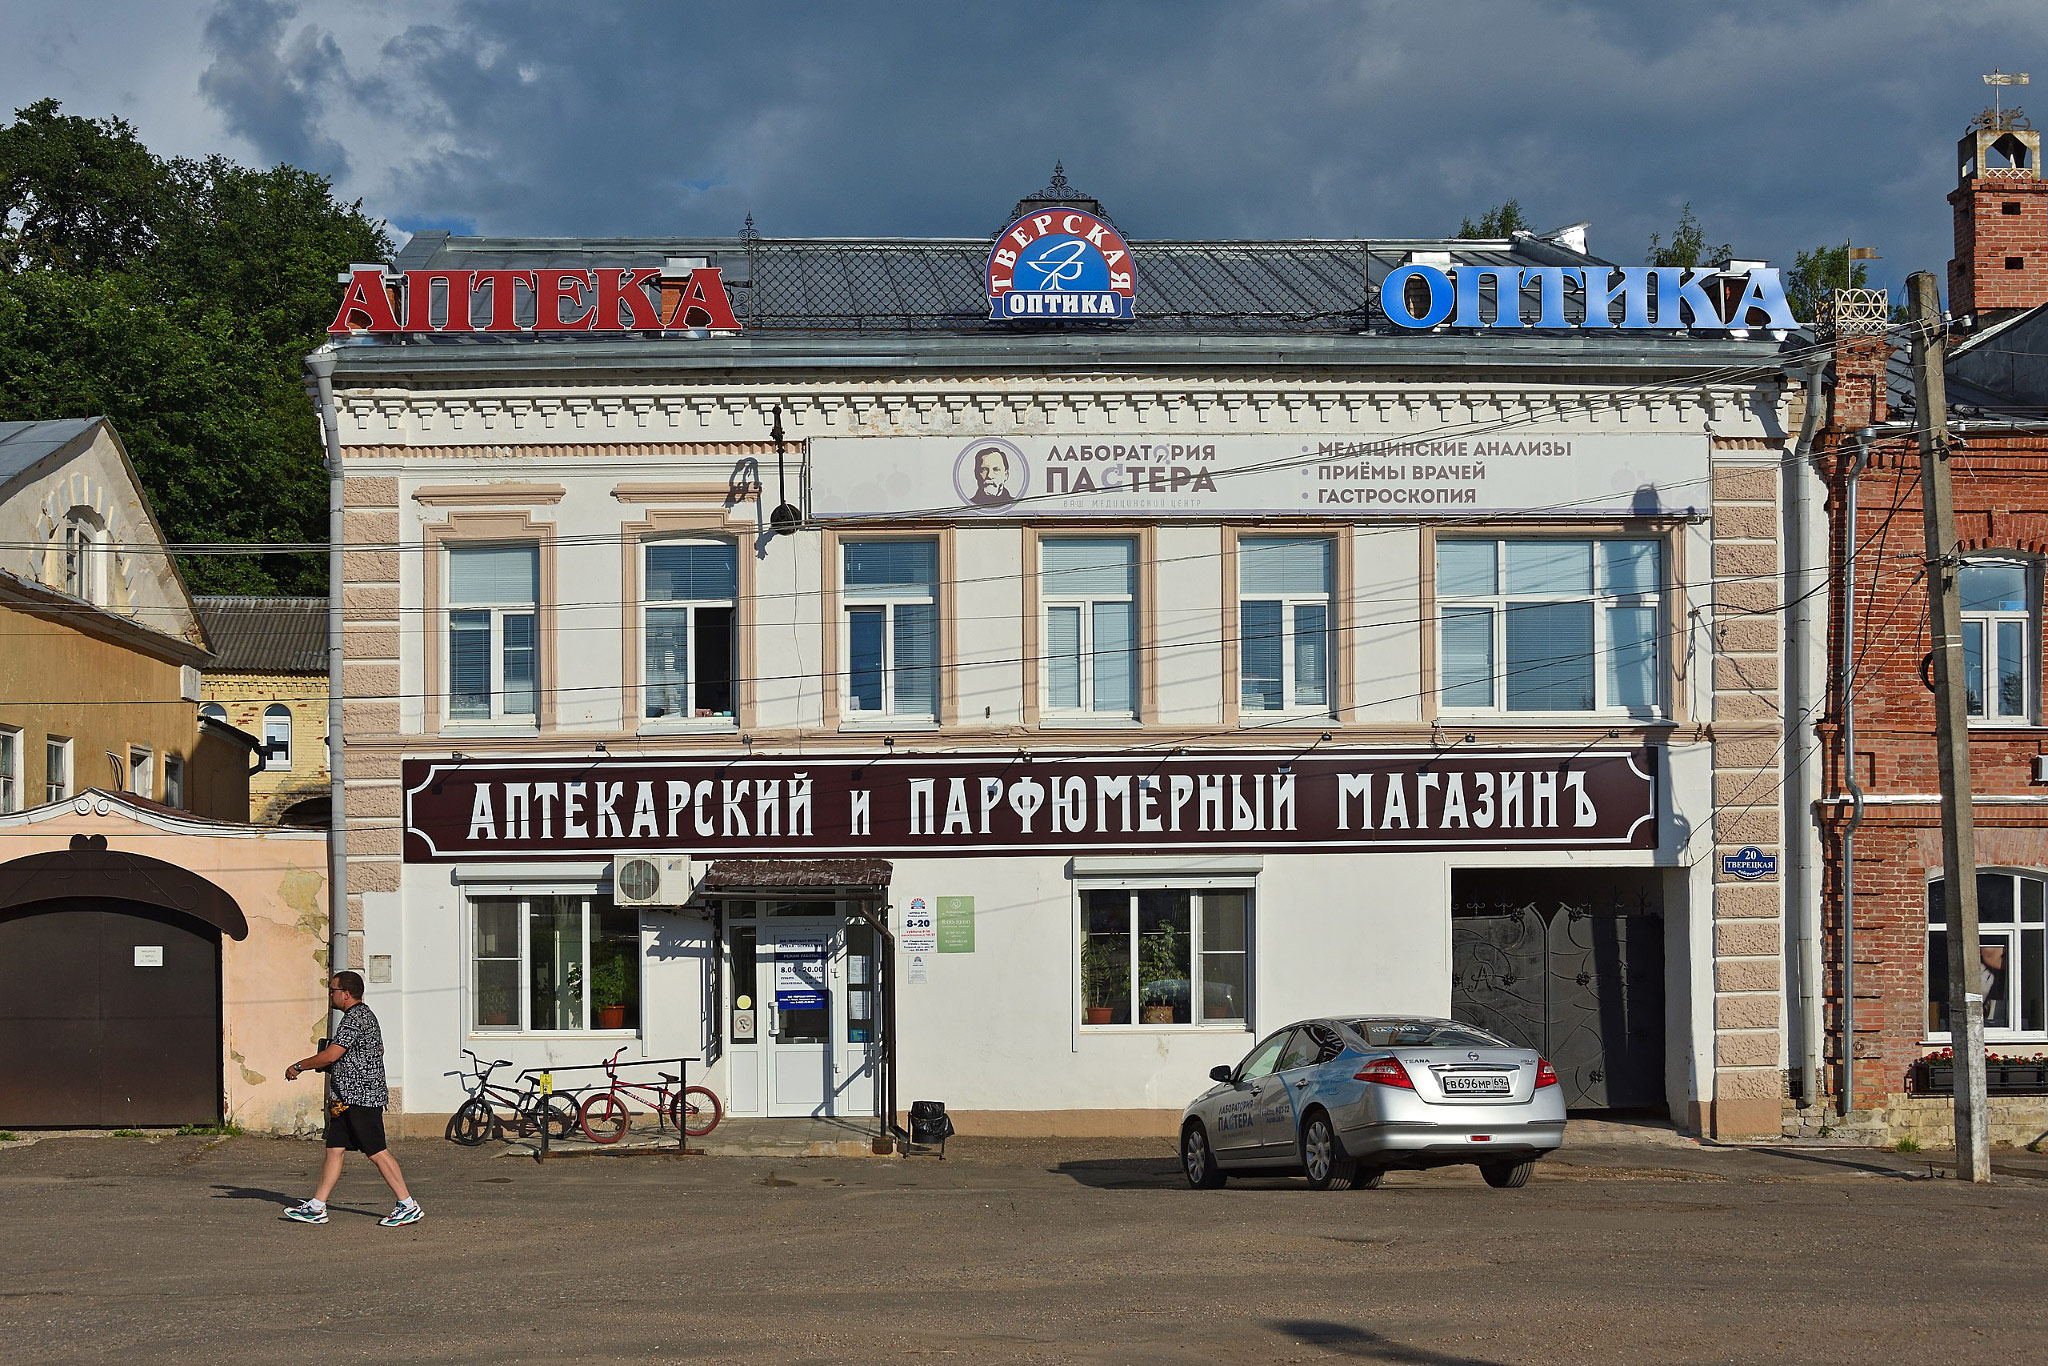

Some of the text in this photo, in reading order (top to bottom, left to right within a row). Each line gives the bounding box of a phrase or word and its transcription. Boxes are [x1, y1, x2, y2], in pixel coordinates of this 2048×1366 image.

[991, 214, 1131, 293] ТВЕРСКАЯ
[327, 266, 742, 334] АПТЕКА
[1010, 294, 1115, 314] ОПТИКА
[1380, 264, 1801, 331] ОПТИКА
[1047, 444, 1216, 464] ЛАБОРАТОРИЯ
[1317, 440, 1572, 459] МЕДИЦИНСКИЕ АНАЛИЗЫ
[1046, 464, 1217, 493] ПАСТЕРА
[1317, 459, 1487, 480] ПРИЁМЫ ВРАЧЕЙ
[1317, 487, 1477, 504] ГАСТРОСКОПИЯ
[466, 771, 814, 840] АПТЕКАРСКИЙ
[908, 770, 1297, 836] ПАРФЮМЕРНЫЙ
[1336, 769, 1596, 832] МАГАЗИНЪ
[1726, 861, 1774, 869] ТВЕРЕЦКАЯ
[1744, 851, 1757, 860] 20
[906, 919, 930, 928] 8-20
[780, 966, 797, 974] 8.00
[802, 966, 823, 974] 20.00
[1218, 1112, 1254, 1132] ПАСТЕРА
